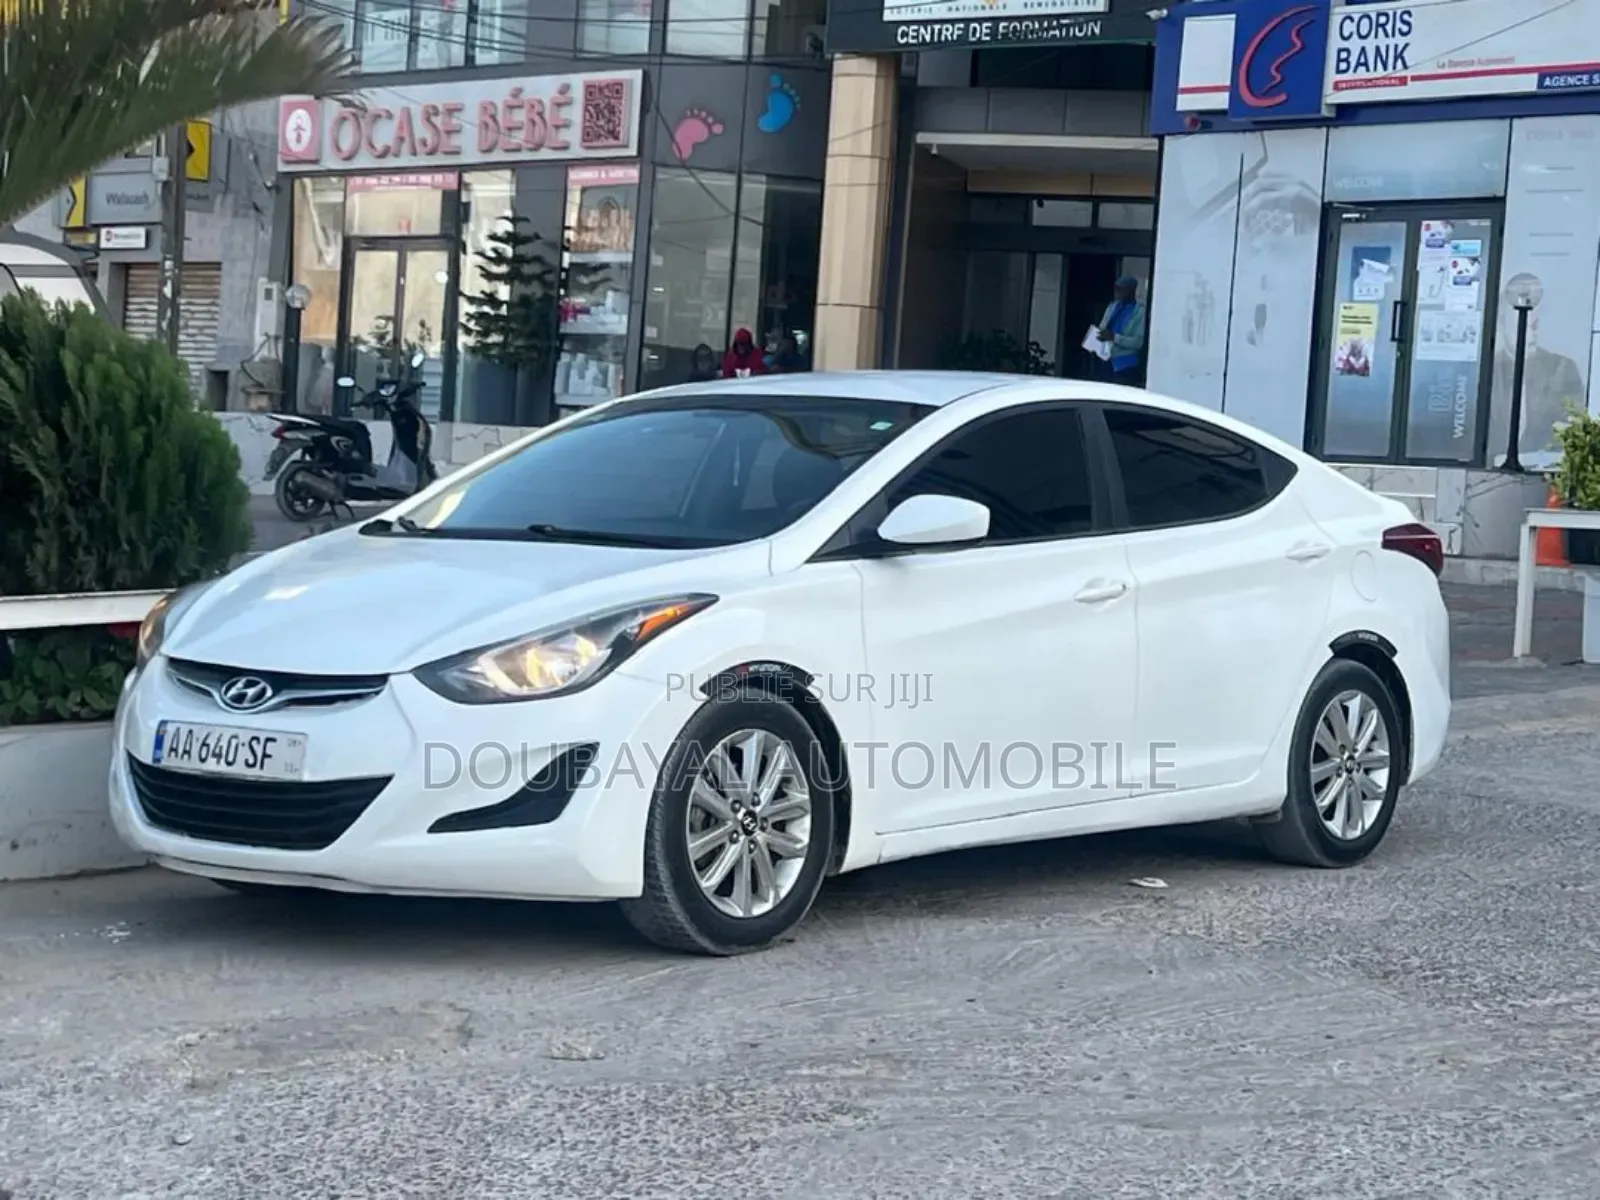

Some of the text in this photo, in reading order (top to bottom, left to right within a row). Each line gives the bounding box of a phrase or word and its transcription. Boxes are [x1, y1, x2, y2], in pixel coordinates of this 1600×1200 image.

[968, 22, 993, 41] DE
[997, 18, 1102, 40] FORMATION
[1338, 9, 1414, 41] CORIS
[1335, 43, 1411, 75] BANK
[1543, 74, 1590, 87] AGENCE
[476, 83, 573, 152] BÉBÉ
